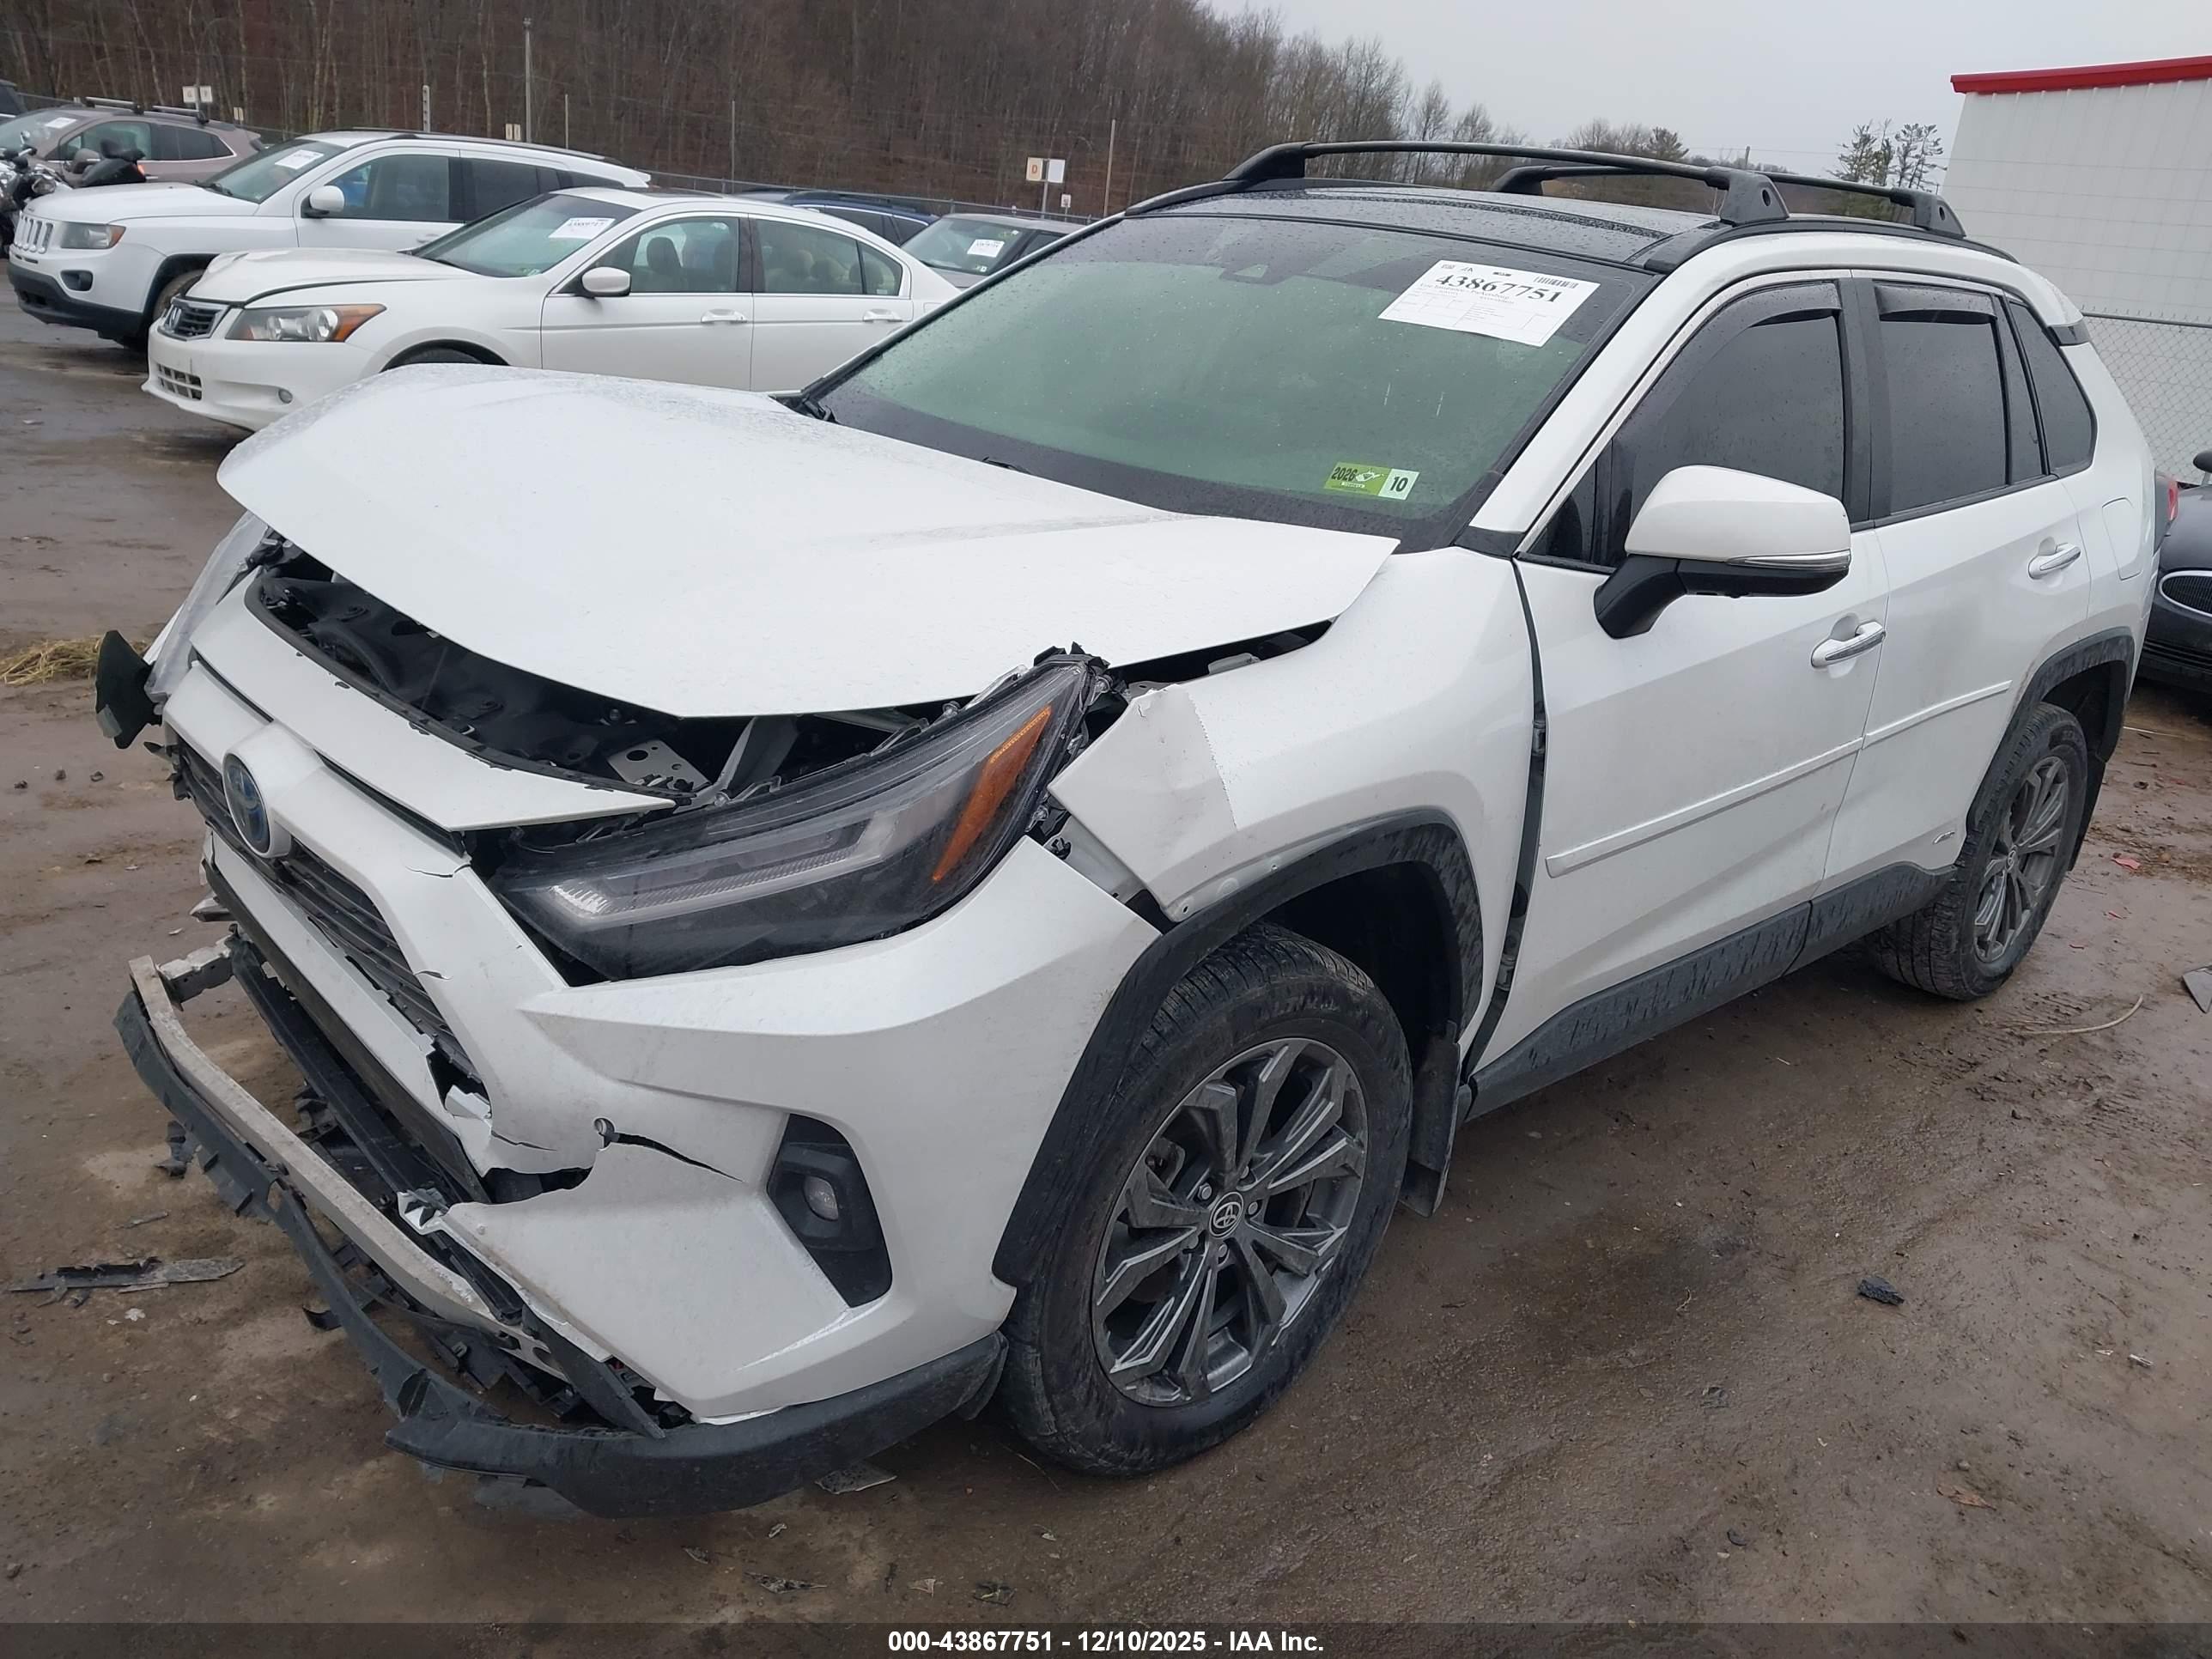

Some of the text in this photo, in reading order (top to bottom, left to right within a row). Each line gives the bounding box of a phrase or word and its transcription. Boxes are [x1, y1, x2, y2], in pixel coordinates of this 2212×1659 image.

[1031, 164, 1038, 174] D
[1435, 274, 1563, 302] 43867751
[1331, 466, 1409, 492] 2026 10
